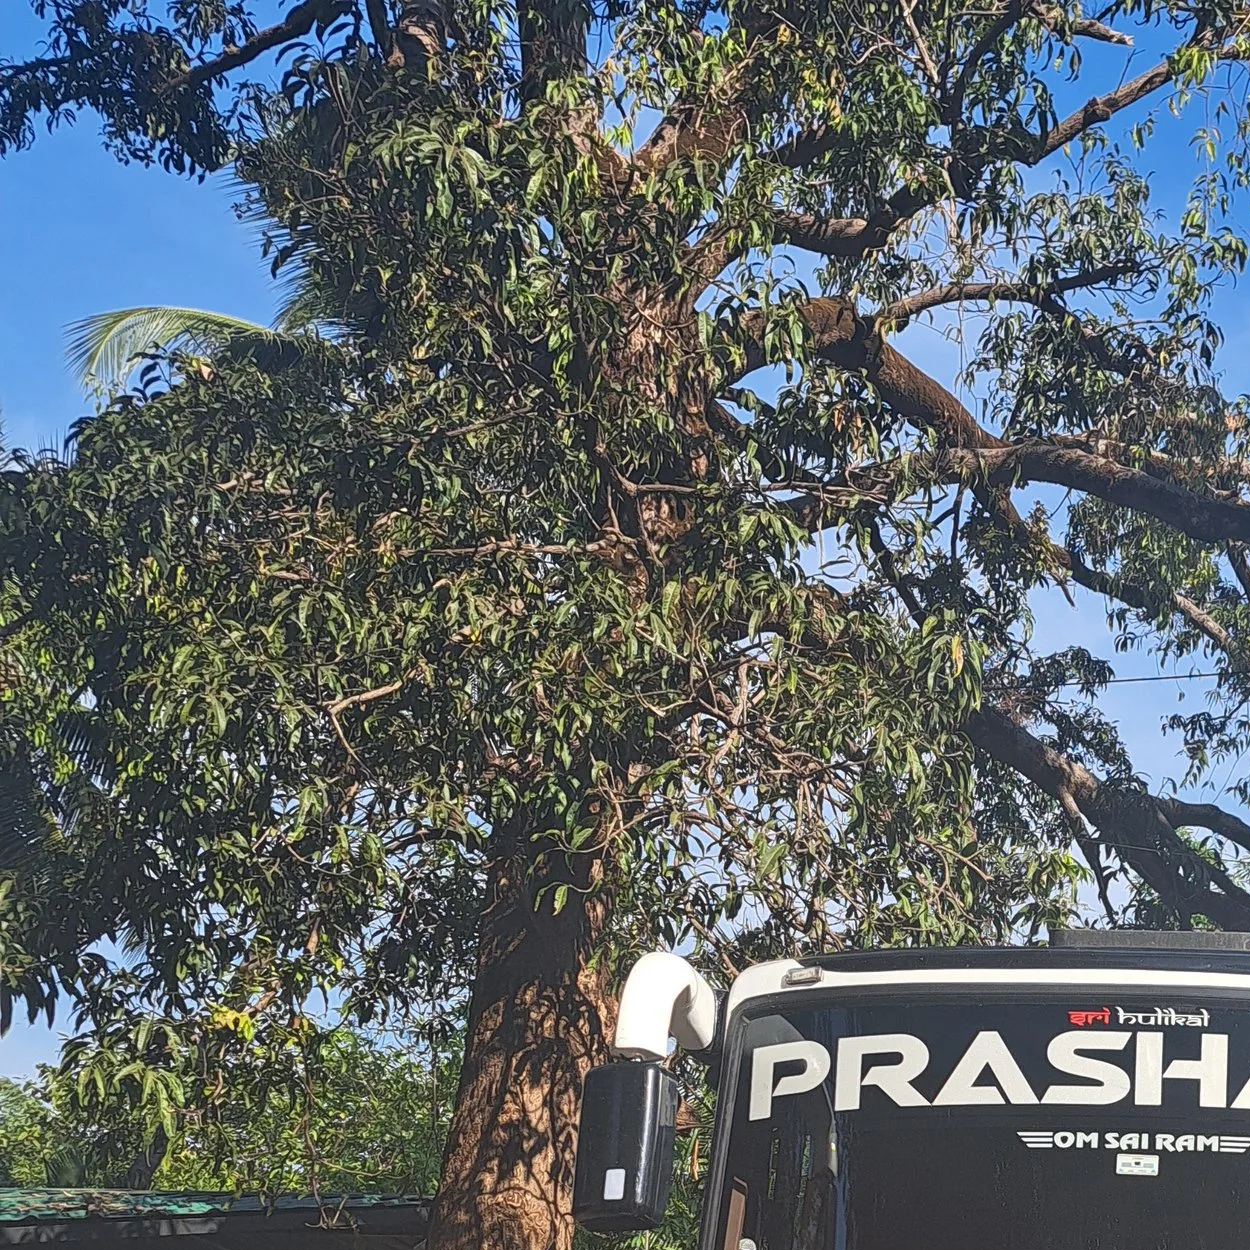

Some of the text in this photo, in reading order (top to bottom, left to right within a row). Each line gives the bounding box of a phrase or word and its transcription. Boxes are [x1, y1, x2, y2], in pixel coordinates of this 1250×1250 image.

[1053, 1131, 1219, 1152] OM SAI RAM
